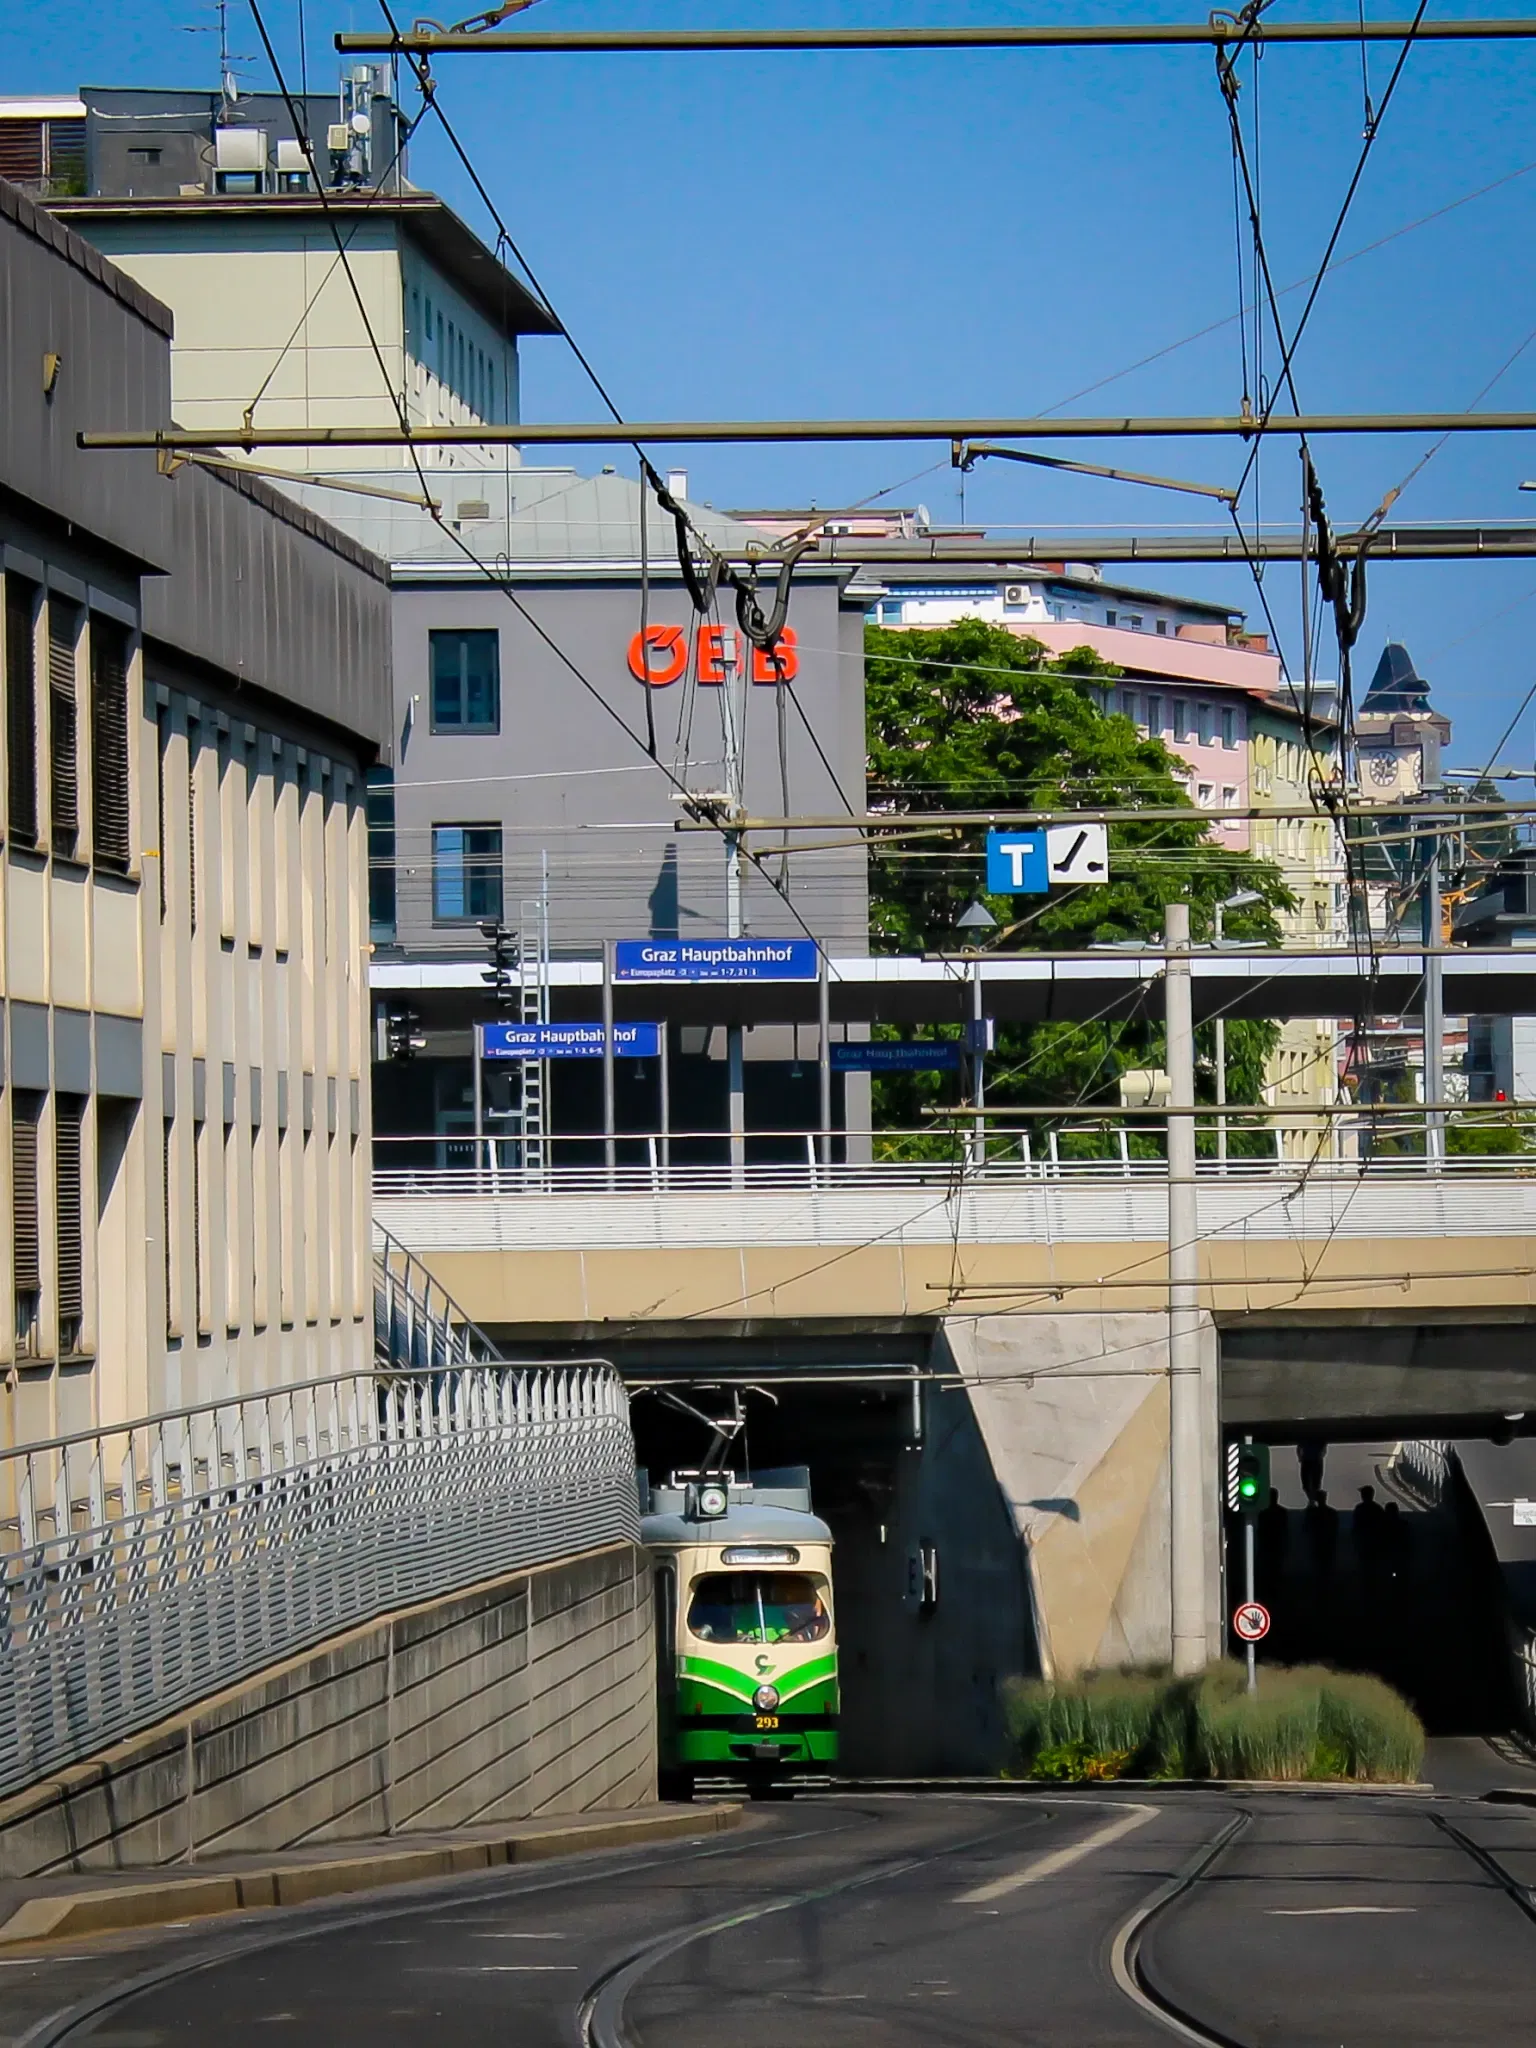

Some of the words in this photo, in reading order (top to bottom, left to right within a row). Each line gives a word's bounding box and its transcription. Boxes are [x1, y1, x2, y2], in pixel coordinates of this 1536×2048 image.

[1000, 844, 1034, 886] T
[641, 948, 677, 963] Graz
[681, 946, 793, 965] Hauptbahnhof
[505, 1030, 537, 1043] Graz
[540, 1028, 637, 1044] Hauptbahhof
[755, 1716, 779, 1729] 293
